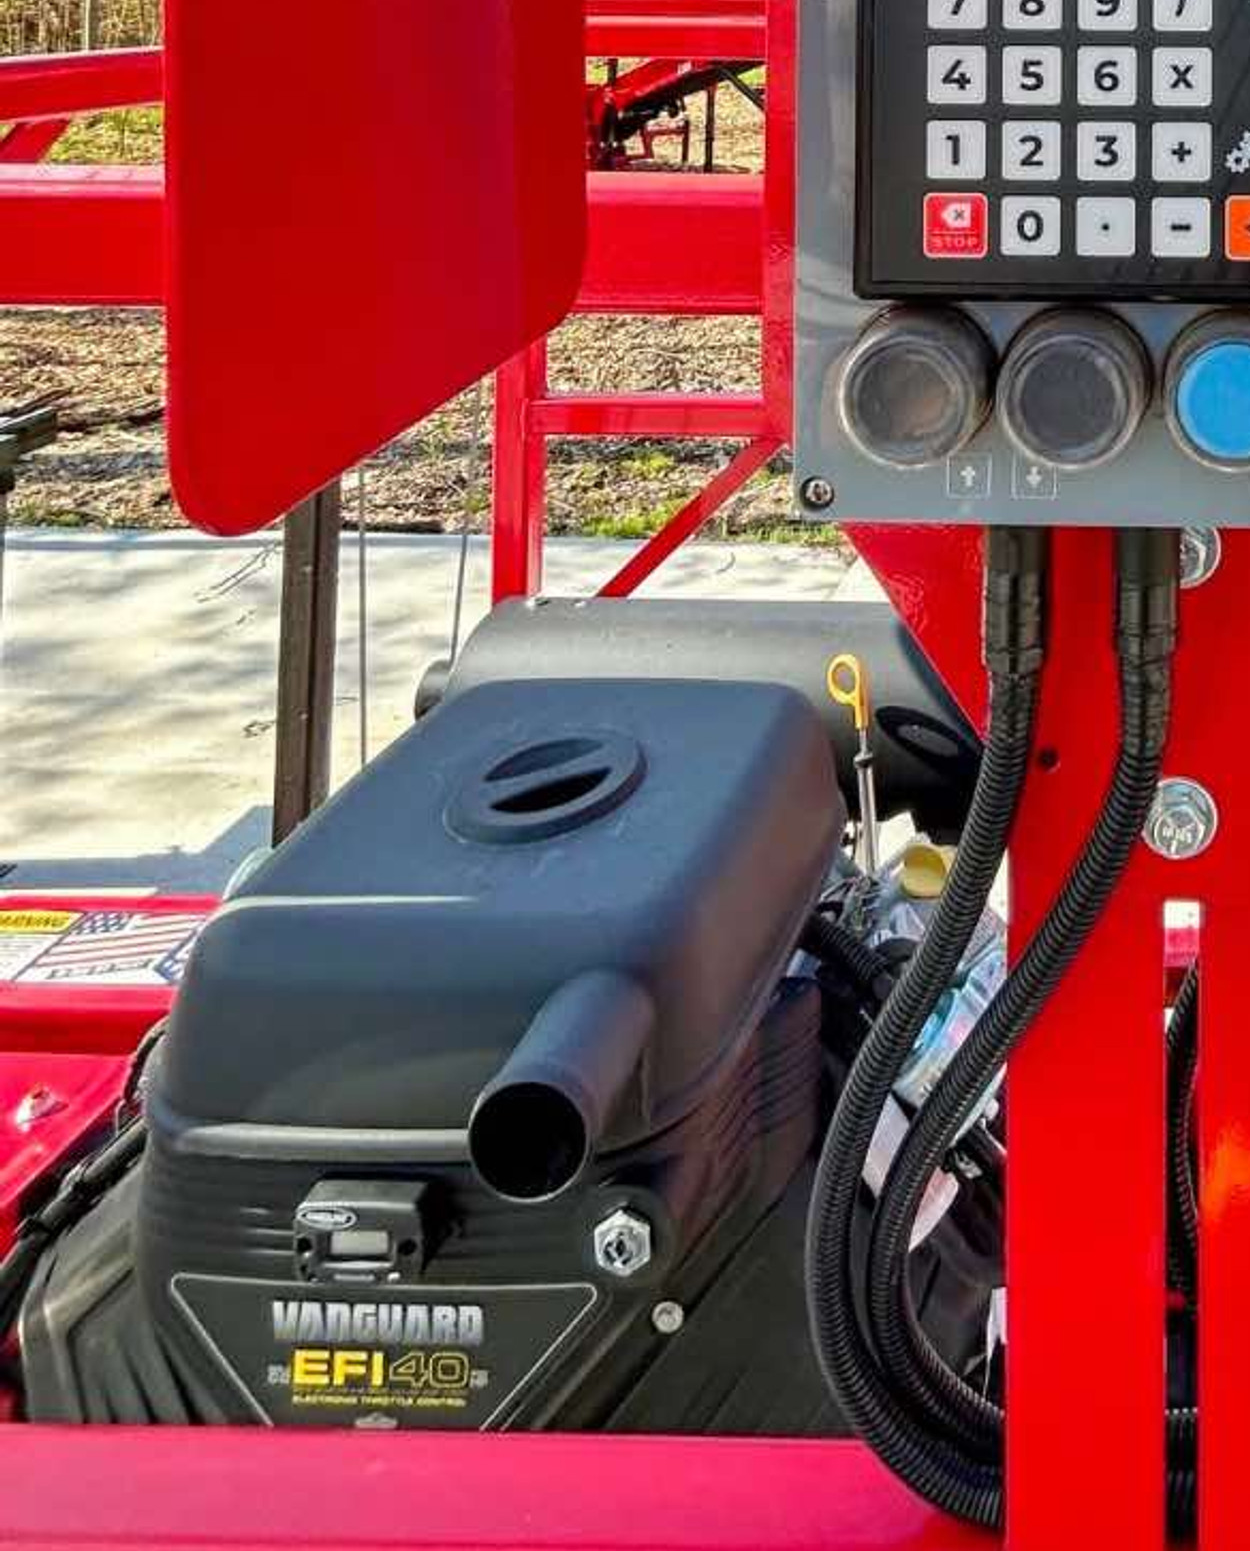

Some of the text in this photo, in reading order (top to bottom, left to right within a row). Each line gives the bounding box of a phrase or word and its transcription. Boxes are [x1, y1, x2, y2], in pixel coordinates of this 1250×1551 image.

[942, 59, 971, 90] 4
[1020, 59, 1044, 91] 5
[1094, 60, 1119, 92] 6
[945, 135, 961, 166] 1
[1019, 135, 1044, 166] 2
[1095, 135, 1119, 167] 3
[1017, 210, 1044, 242] 0
[931, 236, 978, 249] STOP
[272, 1300, 484, 1345] VANGUARD
[293, 1348, 385, 1387] EFI
[389, 1351, 470, 1389] 40
